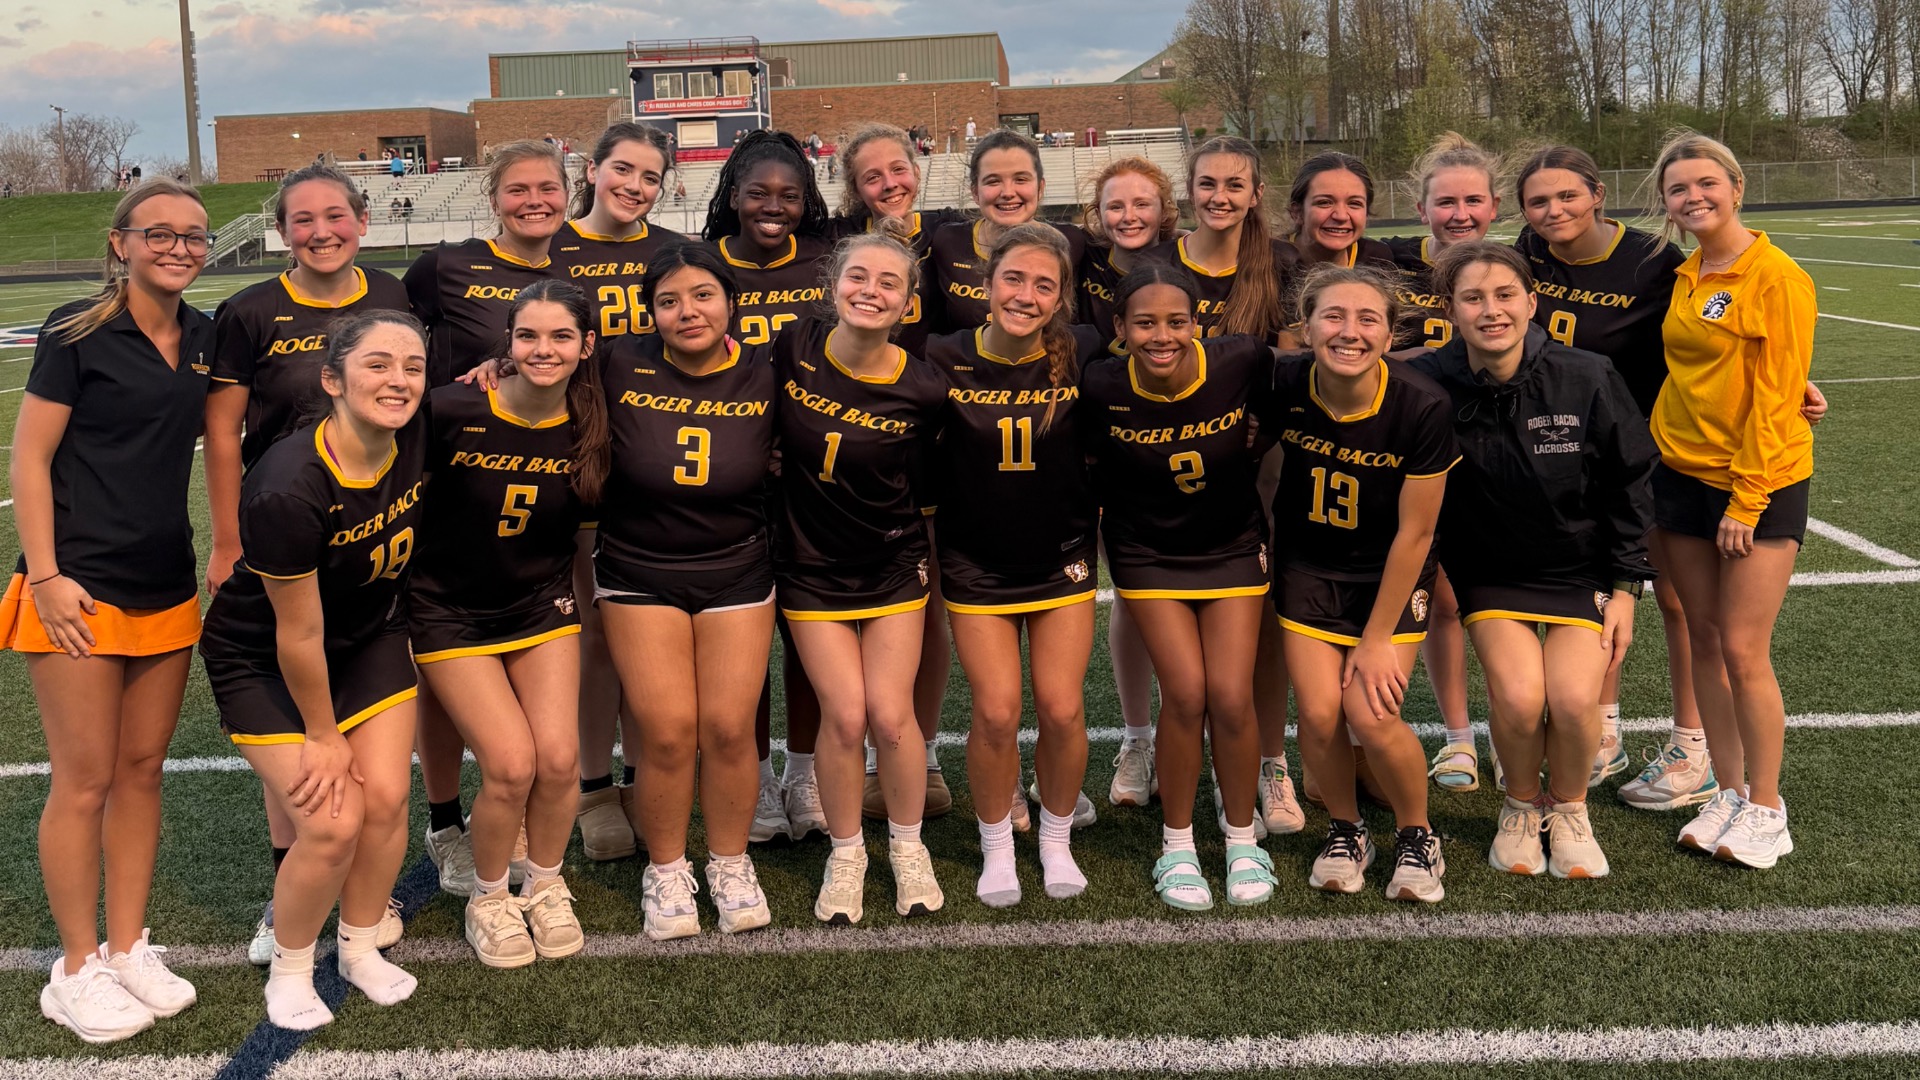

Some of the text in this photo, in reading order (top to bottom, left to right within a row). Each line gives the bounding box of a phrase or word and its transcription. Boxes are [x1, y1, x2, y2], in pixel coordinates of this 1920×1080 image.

[568, 262, 618, 278] OGER
[464, 285, 521, 301] ROGE
[765, 287, 825, 304] BACON
[1532, 278, 1637, 309] OGER BACON
[267, 334, 327, 356] ROGE
[1548, 309, 1577, 348] 9
[619, 390, 769, 417] ROGER BACON
[784, 379, 915, 435] ROGER BACON
[948, 387, 1012, 405] ROGER
[1109, 402, 1246, 445] ROGER BACON
[1527, 414, 1581, 431] ROGER BACON
[450, 451, 524, 471] ROGER
[673, 425, 711, 487] 3
[818, 431, 843, 485] 1
[997, 416, 1036, 471] 11
[1281, 429, 1404, 468] ROGER BACON
[1533, 441, 1581, 455] LACROSSE
[1168, 450, 1207, 494] 2
[497, 484, 539, 538] 5
[1308, 466, 1360, 530] 13
[328, 512, 384, 547] OGER
